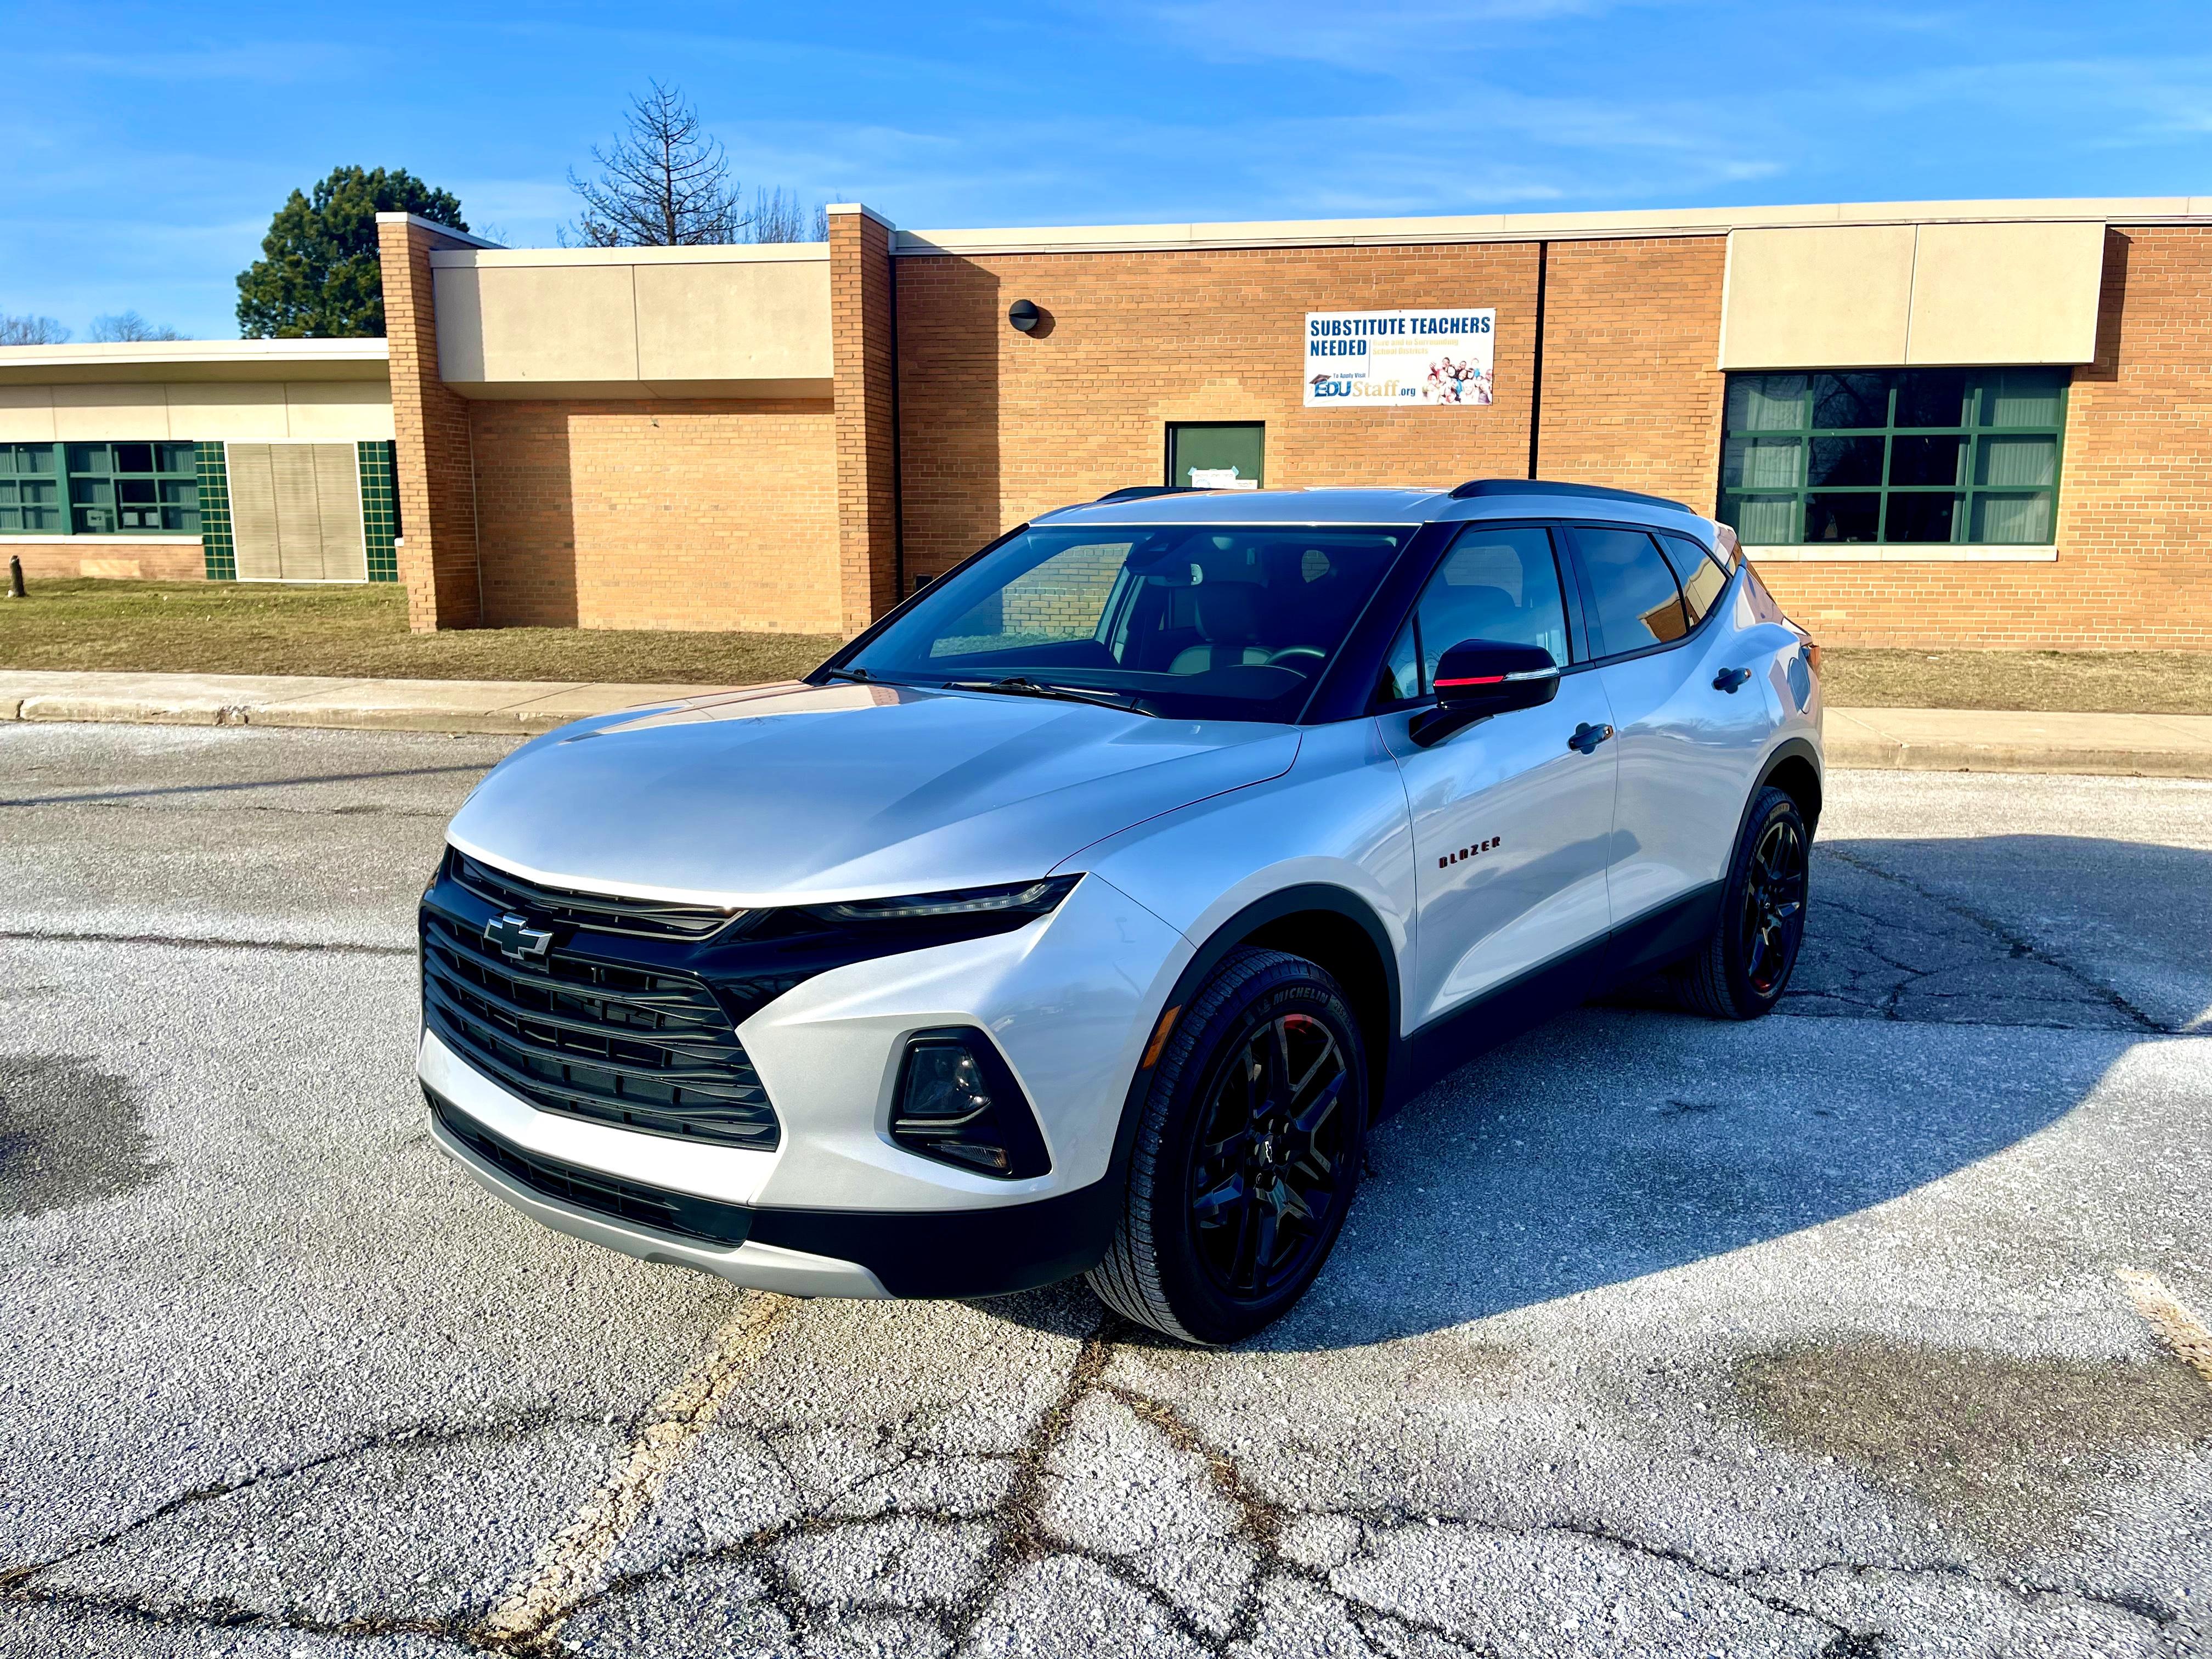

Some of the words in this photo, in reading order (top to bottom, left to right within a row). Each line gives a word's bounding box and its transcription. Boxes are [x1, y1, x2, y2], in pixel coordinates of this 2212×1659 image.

[1310, 318, 1406, 336] SUBSTITUTE
[1410, 317, 1491, 334] TEACHERS
[1310, 339, 1367, 356] NEEDED
[1415, 338, 1459, 346] Surrounding
[1438, 836, 1501, 868] BLAZER
[1273, 987, 1328, 1005] MICHELIN
